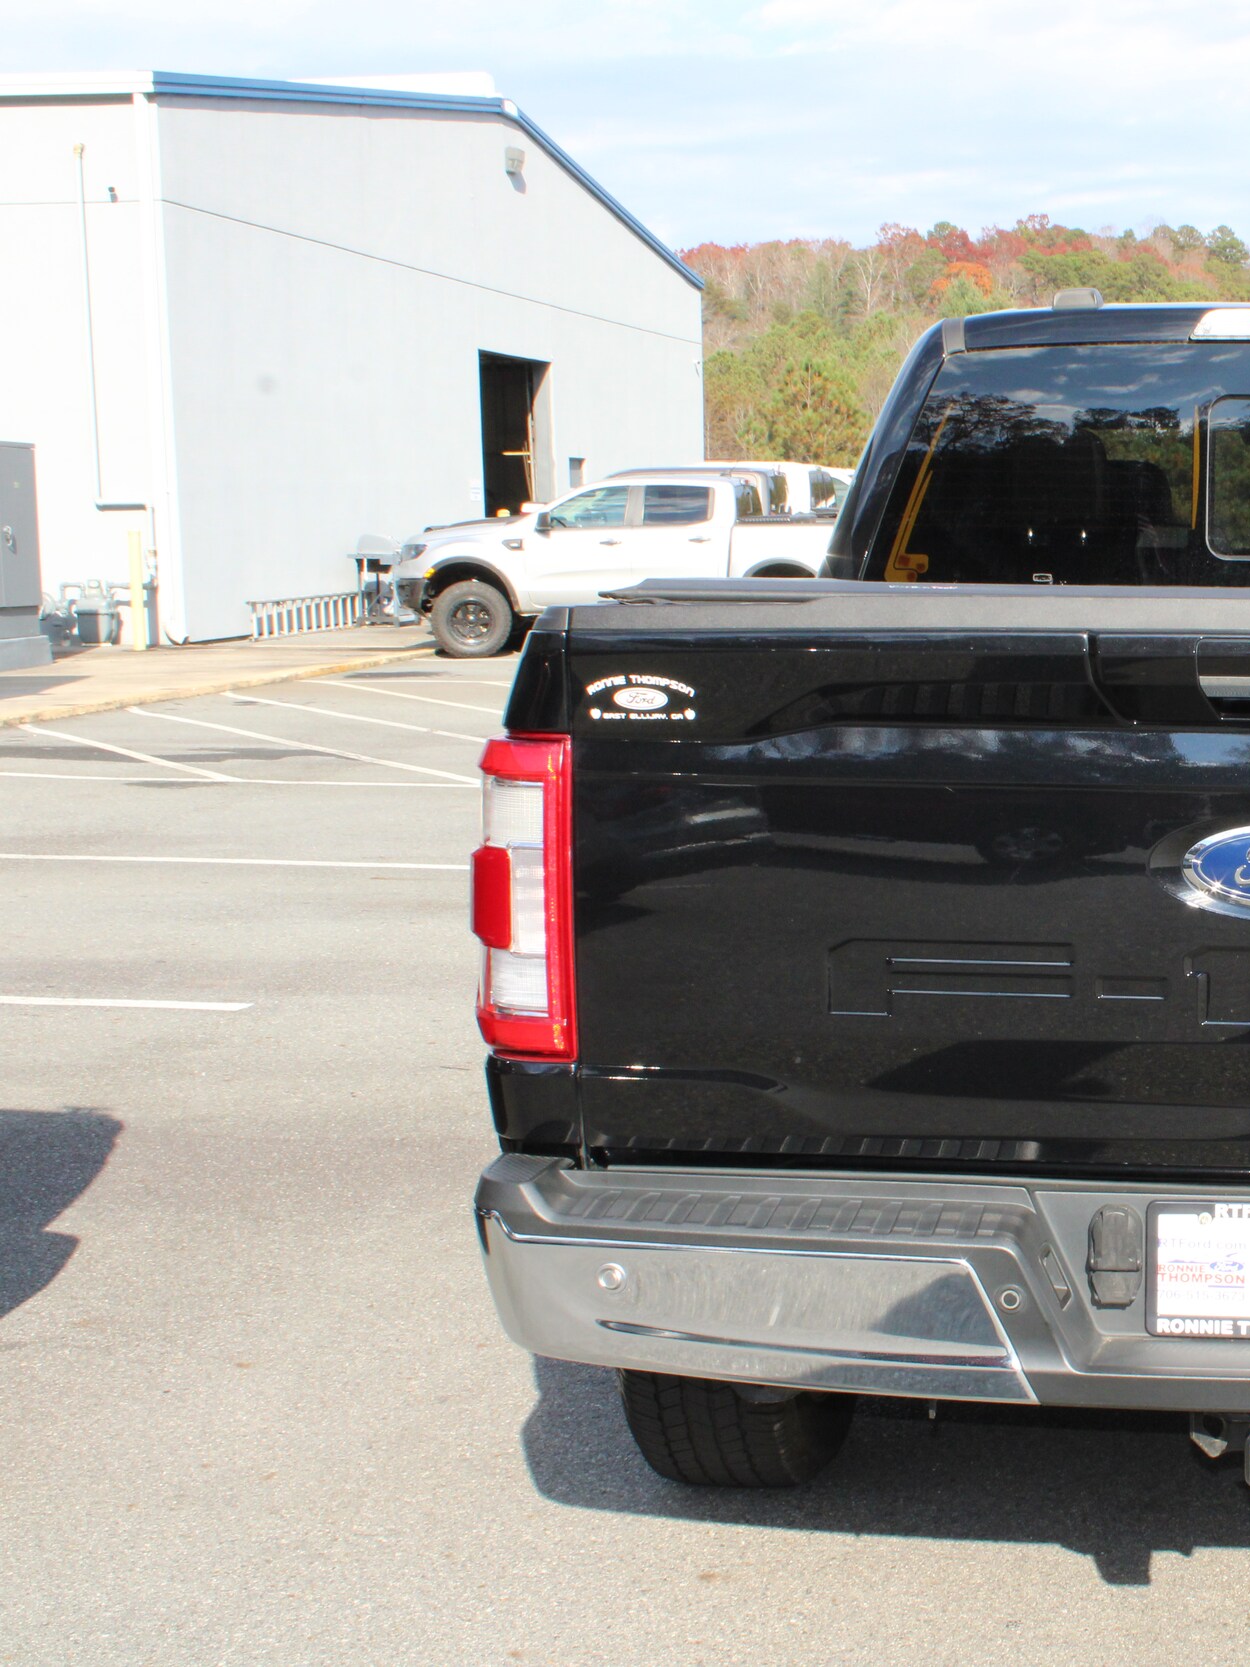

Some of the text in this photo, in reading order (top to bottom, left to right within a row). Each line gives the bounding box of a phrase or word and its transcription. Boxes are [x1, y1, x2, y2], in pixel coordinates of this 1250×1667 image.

[586, 675, 695, 697] RONNIE THOMPSON
[627, 692, 656, 704] Ford
[1158, 1237, 1246, 1250] RTFordcom
[1158, 1263, 1206, 1273] RONNIE
[1158, 1272, 1245, 1284] THOMPSON
[1157, 1318, 1234, 1335] RONNIE
